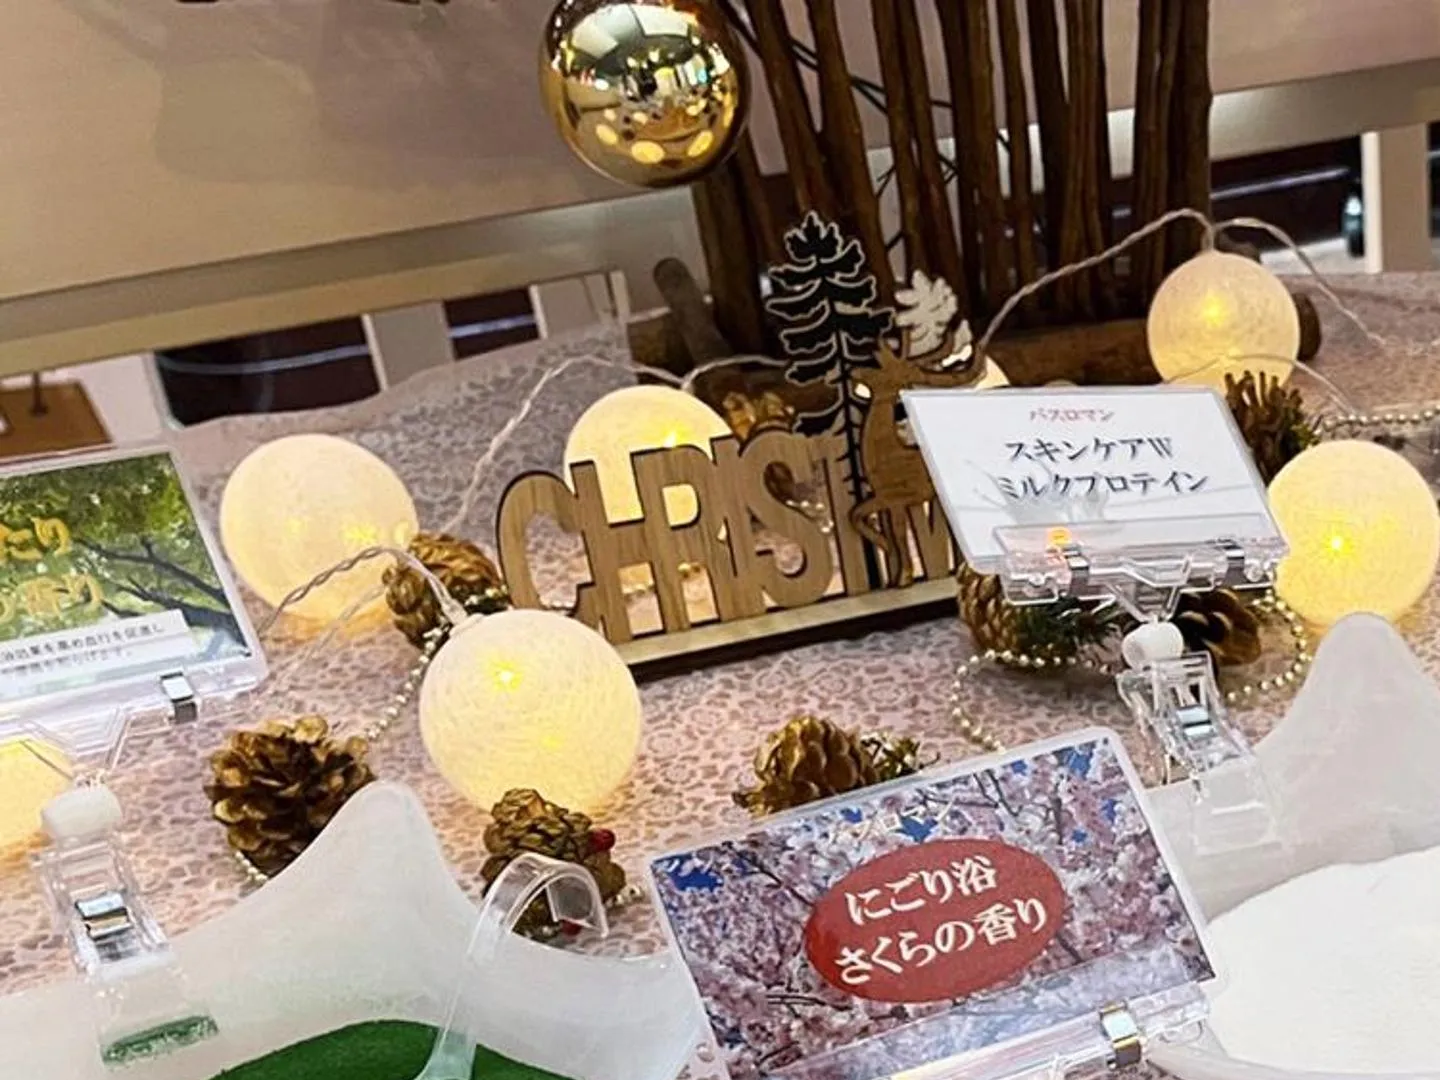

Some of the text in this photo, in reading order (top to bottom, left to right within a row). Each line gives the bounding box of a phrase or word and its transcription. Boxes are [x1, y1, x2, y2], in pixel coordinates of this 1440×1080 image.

[1029, 408, 1116, 424] バスロマン
[998, 471, 1210, 500] ミルクプロテイン
[845, 855, 998, 927] にごり浴
[833, 897, 1048, 986] さくらの香り
